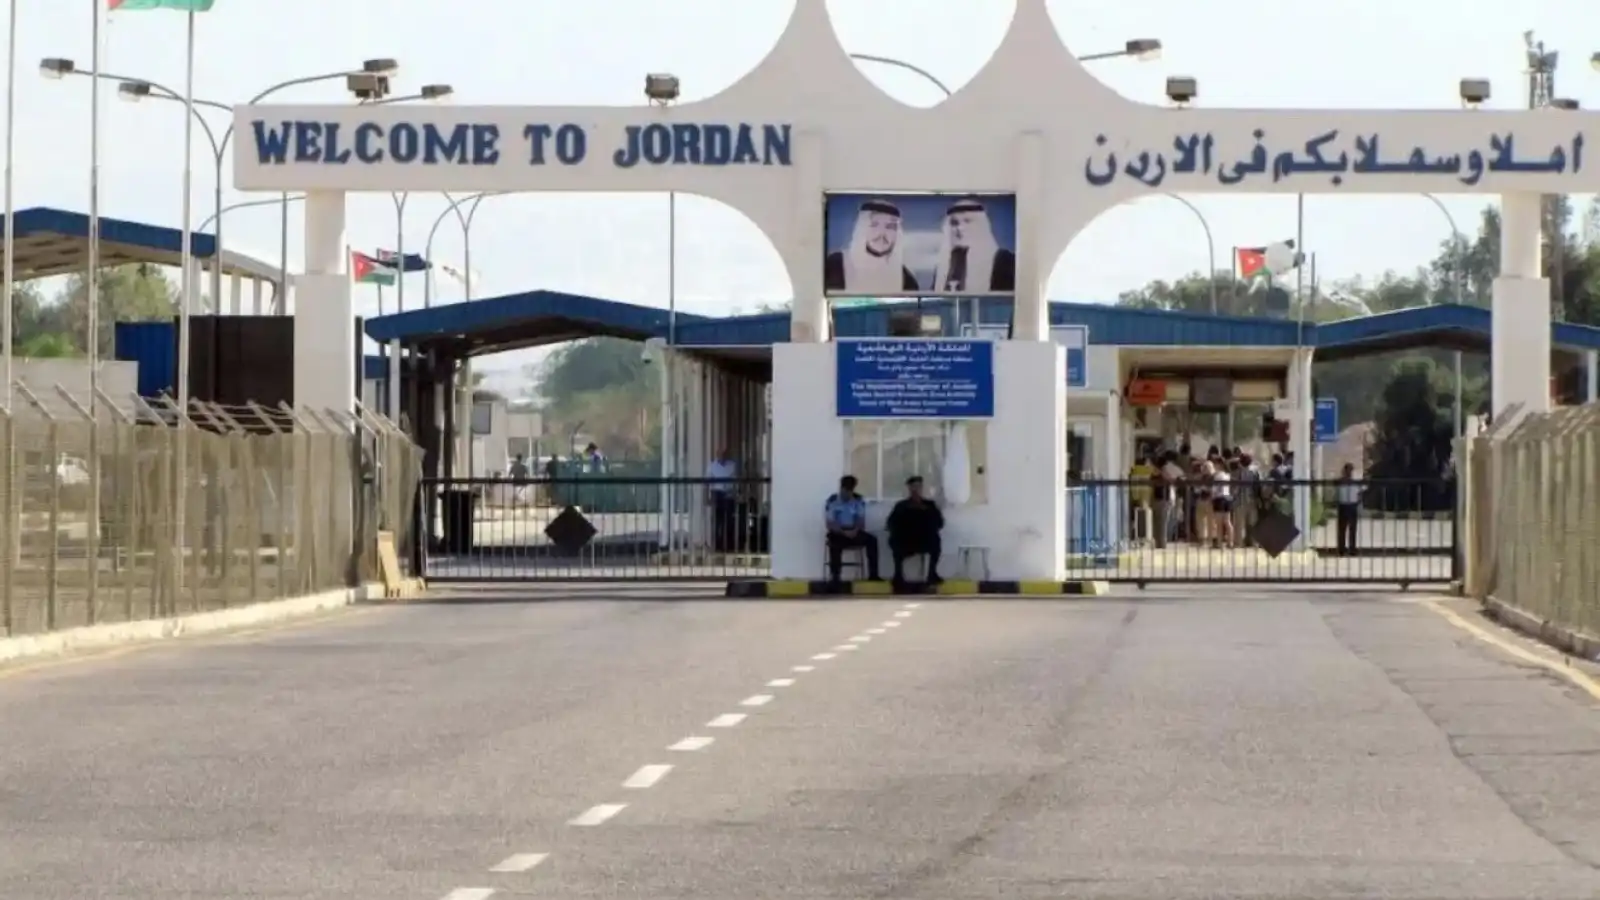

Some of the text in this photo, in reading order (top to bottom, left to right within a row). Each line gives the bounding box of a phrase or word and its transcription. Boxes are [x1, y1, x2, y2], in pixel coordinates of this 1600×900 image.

[251, 120, 792, 169] WELCOME TO JORDAN
[1273, 130, 1348, 185] بكم
[1353, 134, 1484, 185] وسهلا
[1488, 134, 1583, 174] اهلا
